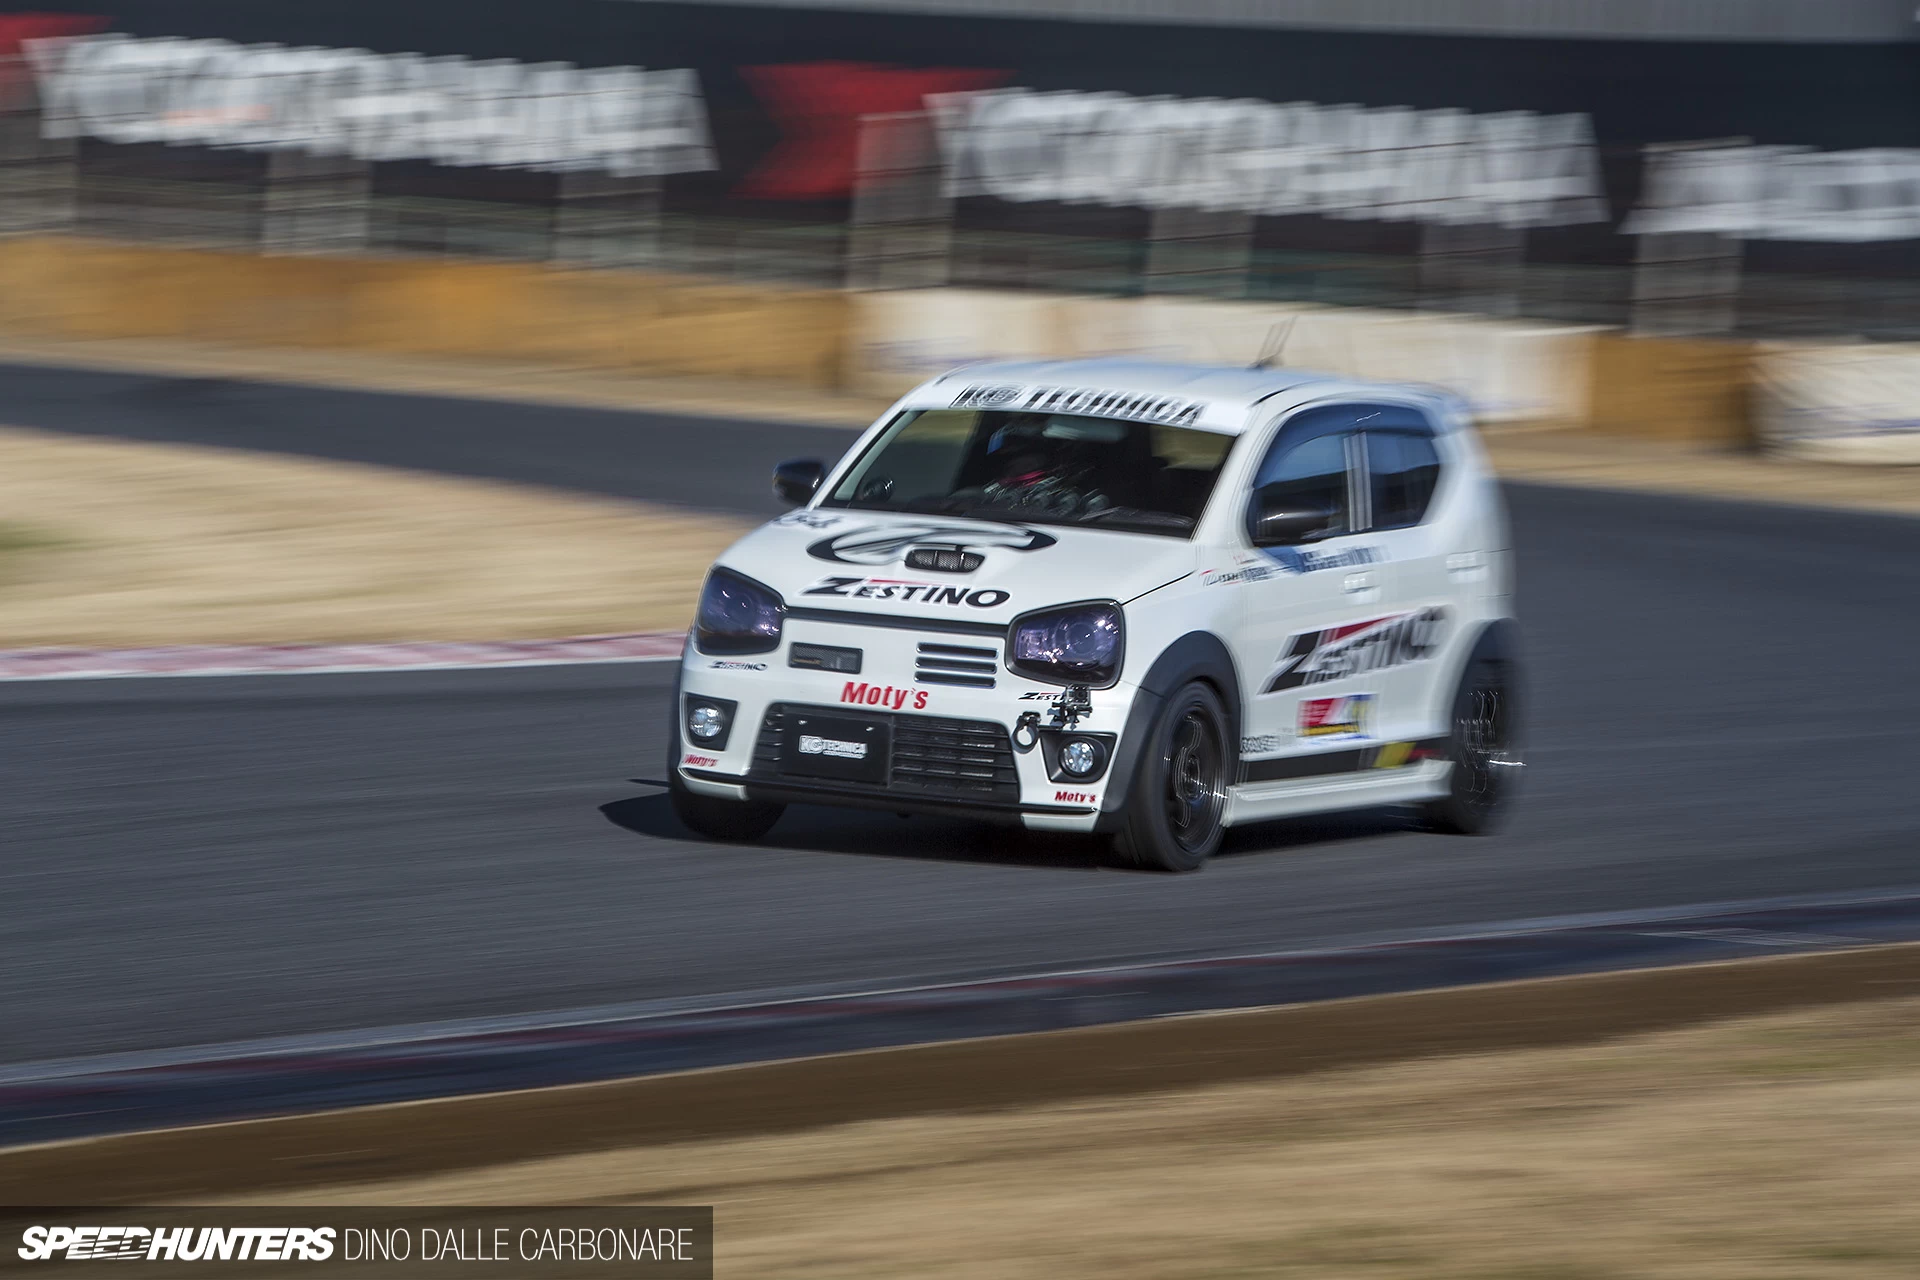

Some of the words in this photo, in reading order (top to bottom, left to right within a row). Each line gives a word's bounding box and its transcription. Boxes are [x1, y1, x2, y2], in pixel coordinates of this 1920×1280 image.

[801, 577, 1011, 608] ZESTINO
[840, 681, 929, 711] Moty's
[1018, 692, 1065, 701] ZESTI
[1054, 791, 1096, 804] Moty's
